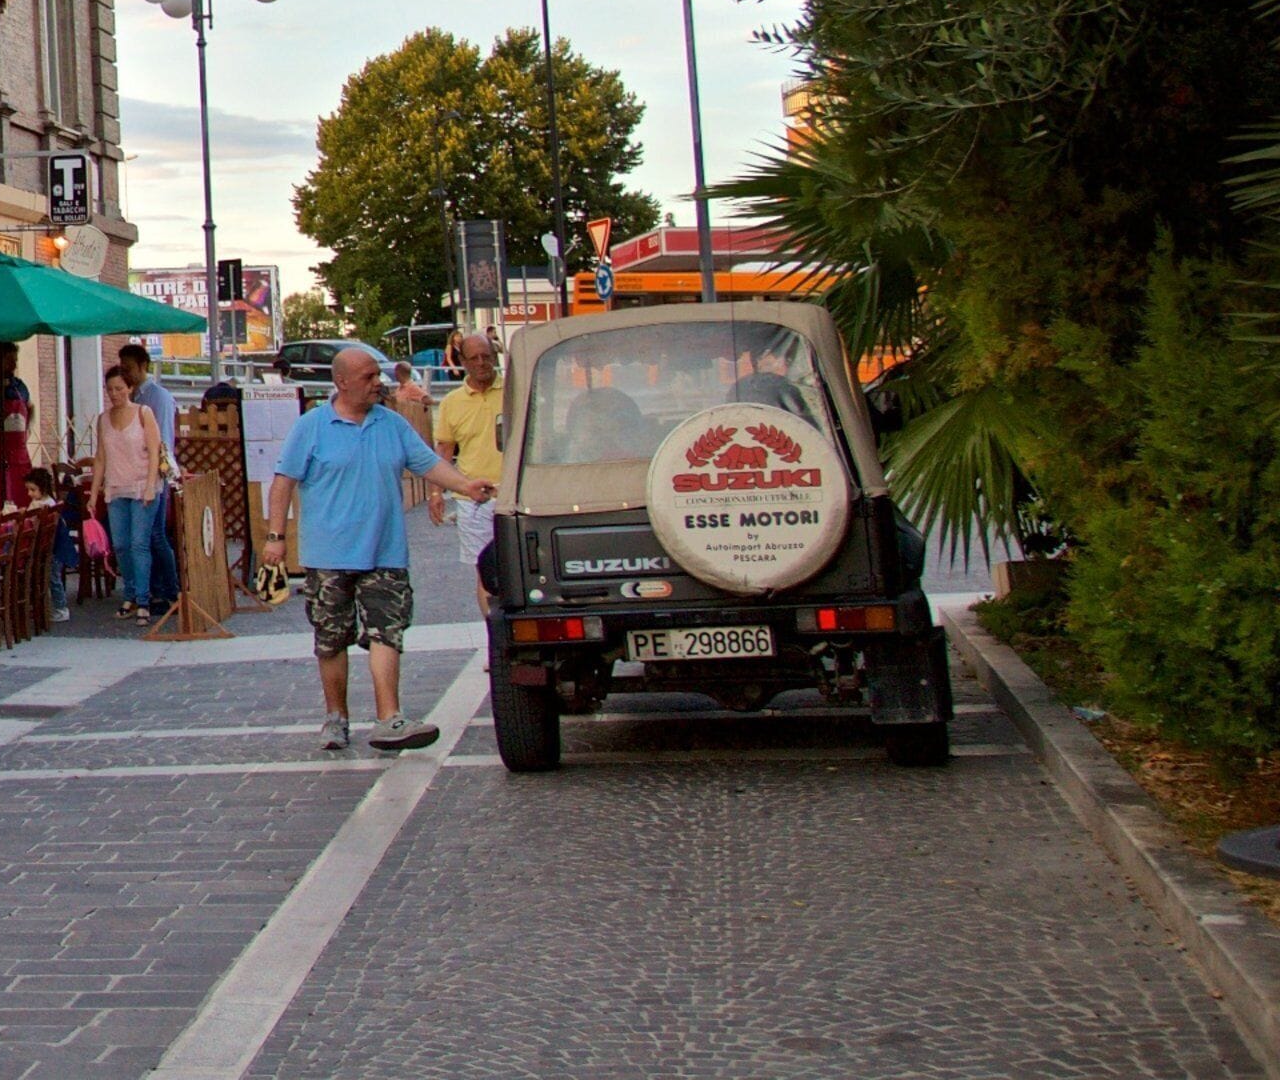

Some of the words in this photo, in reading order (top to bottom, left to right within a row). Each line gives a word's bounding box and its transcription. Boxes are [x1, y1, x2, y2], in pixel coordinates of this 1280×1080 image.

[53, 158, 82, 201] T
[671, 468, 823, 493] SUZUKI
[684, 513, 731, 529] ESSE
[739, 510, 820, 528] MOTORI
[747, 532, 760, 542] by
[705, 543, 762, 553] Autoimport
[764, 541, 806, 551] Abruzzo
[564, 556, 671, 575] SUZUKI
[733, 554, 778, 562] PESCARA
[633, 632, 668, 658] PE
[684, 628, 770, 656] 298866
